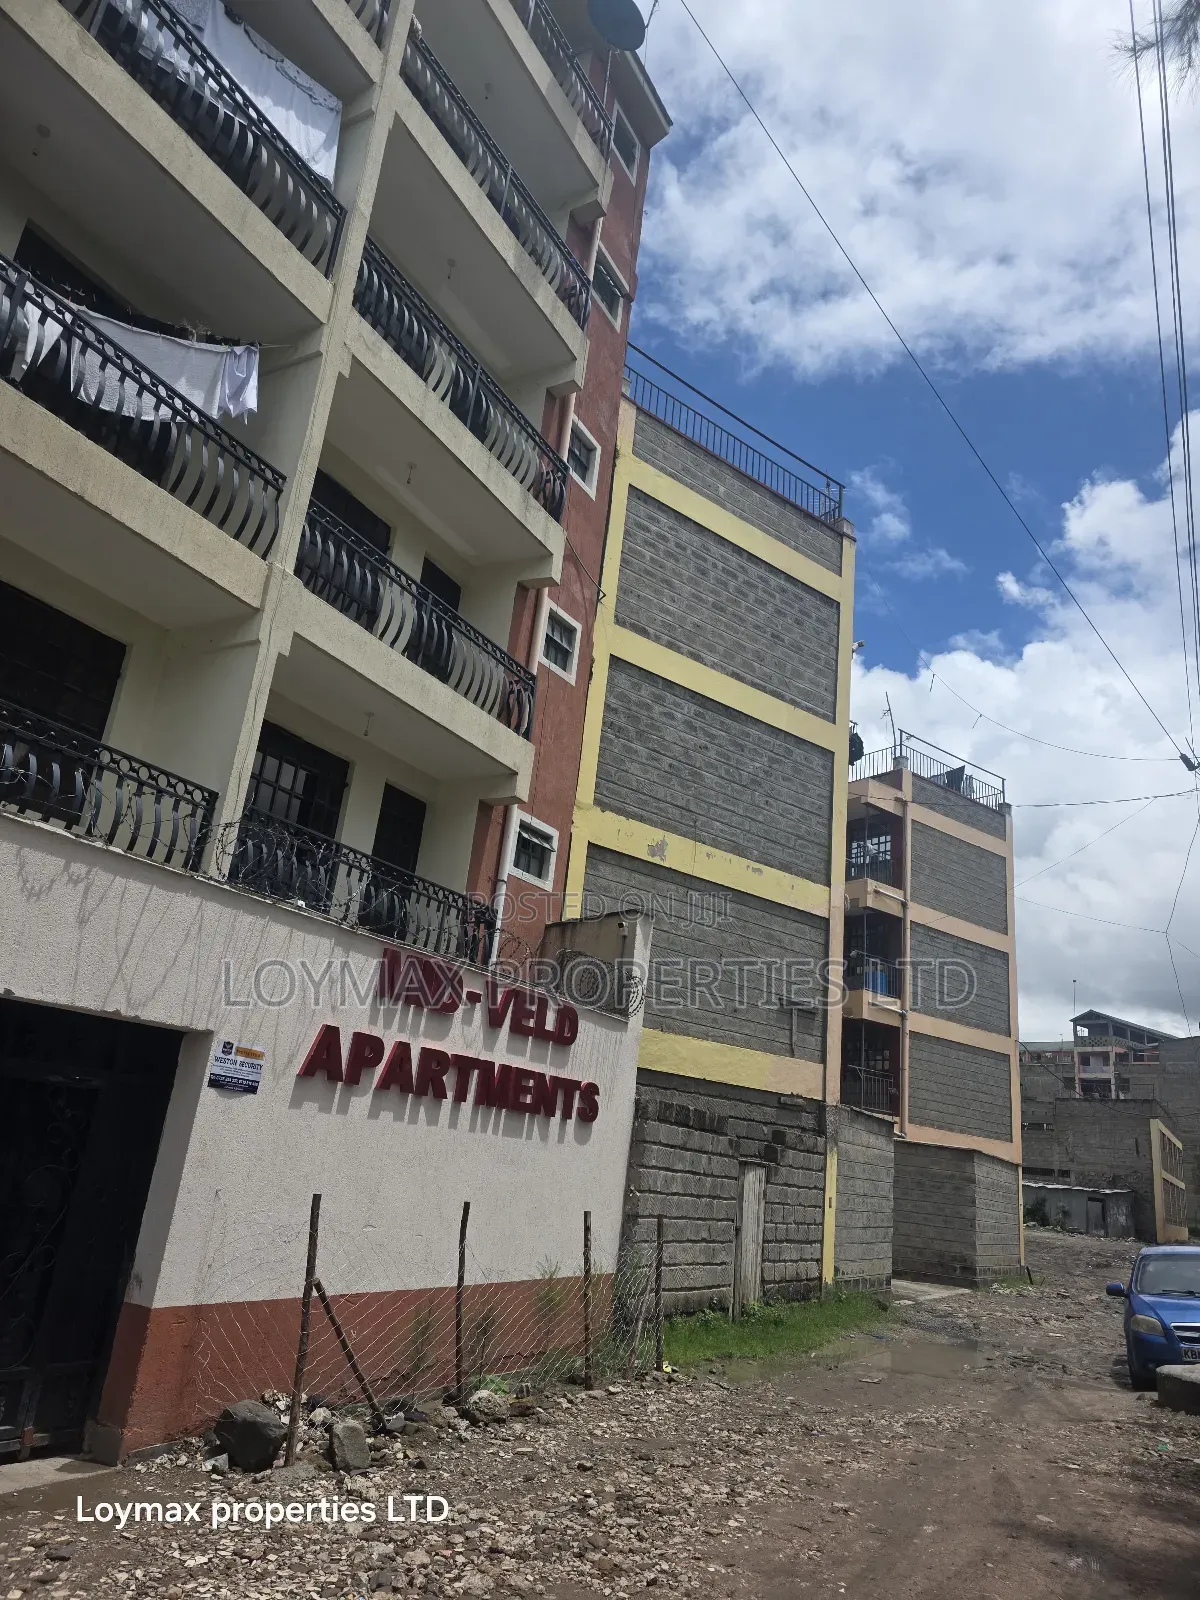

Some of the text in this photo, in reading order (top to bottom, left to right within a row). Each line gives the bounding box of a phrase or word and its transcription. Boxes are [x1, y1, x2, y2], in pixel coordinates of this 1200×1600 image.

[214, 1056, 238, 1066] WESTON
[239, 1061, 263, 1070] SECURITY
[297, 1023, 600, 1123] APARTMENTS
